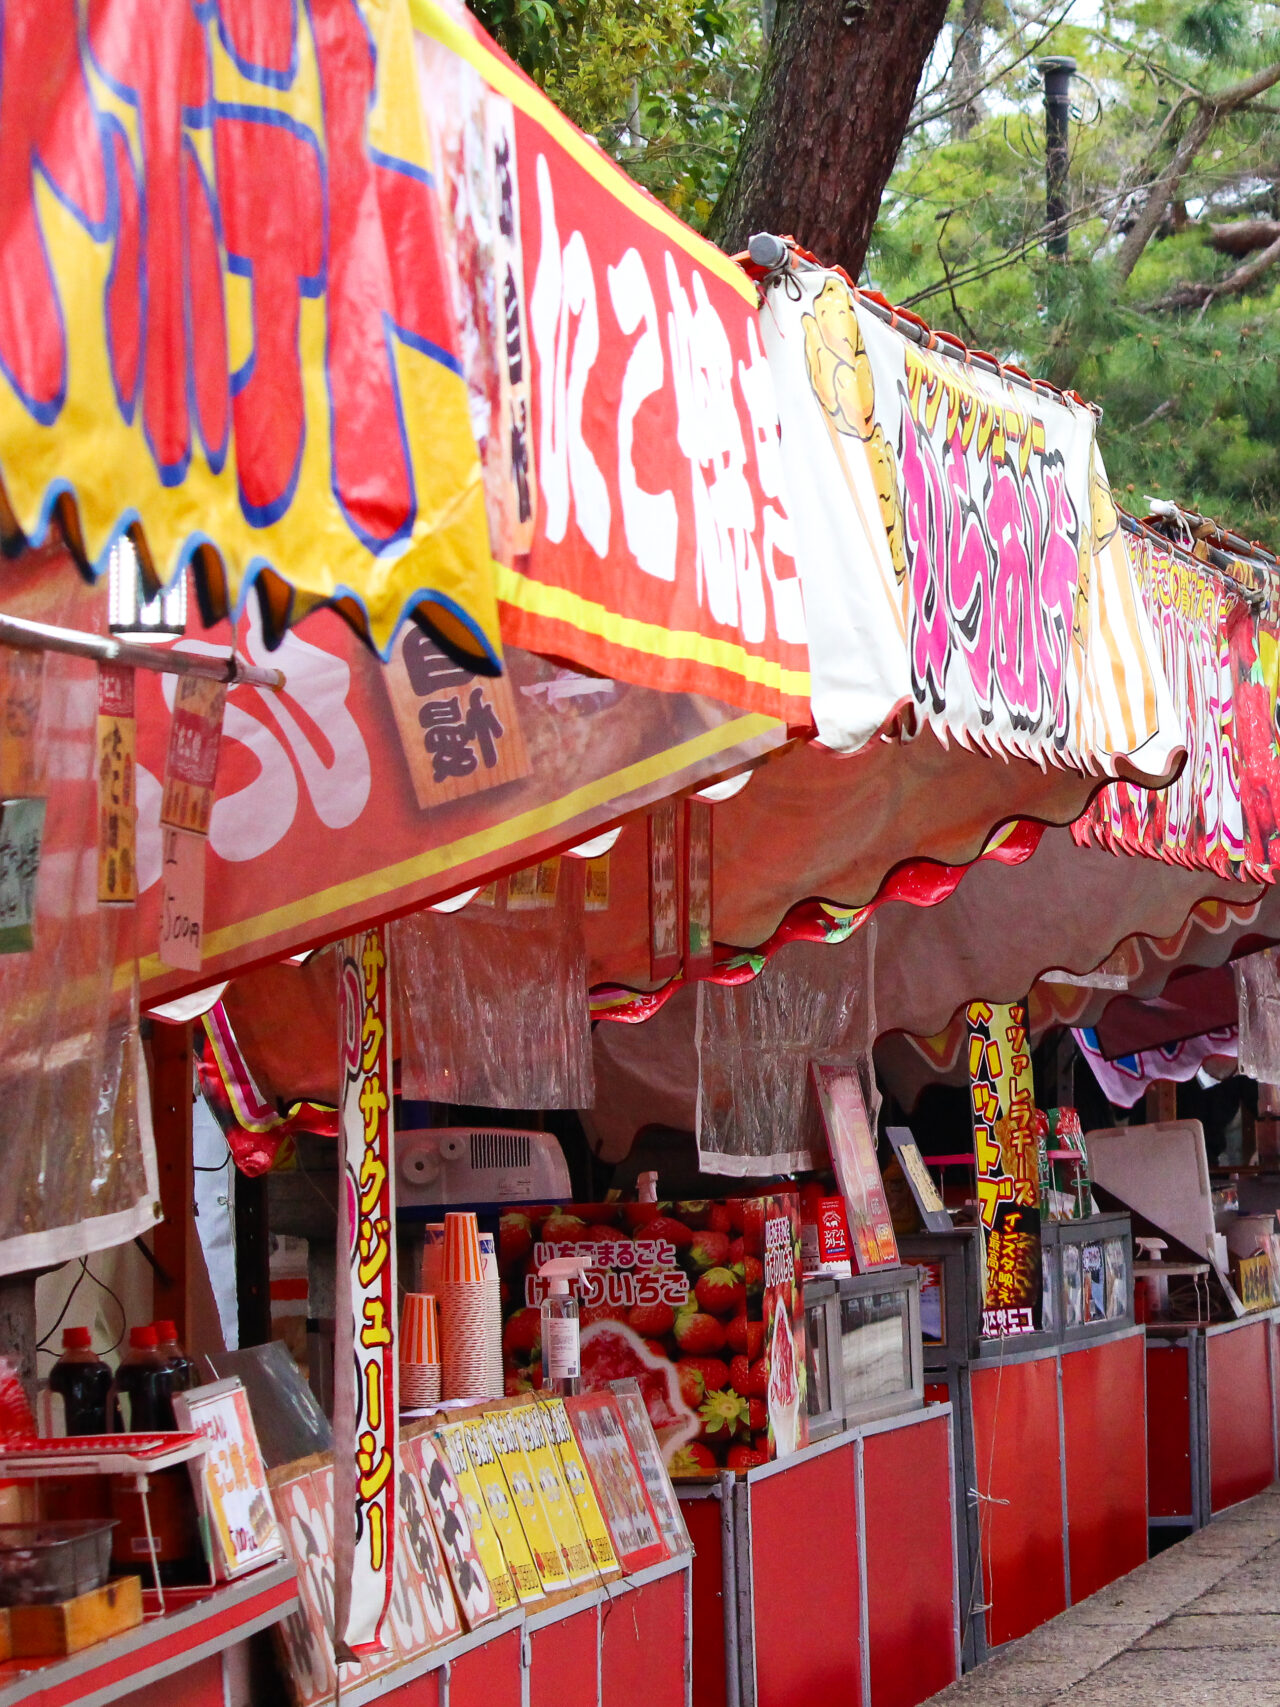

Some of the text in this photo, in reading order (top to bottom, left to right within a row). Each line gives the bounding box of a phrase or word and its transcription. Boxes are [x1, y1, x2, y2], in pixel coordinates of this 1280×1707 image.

[359, 934, 392, 1572] サクサクジューシー
[823, 1228, 845, 1239] コンデンス
[824, 1238, 846, 1249] クリーム
[998, 1212, 1022, 1304] インスタ映え
